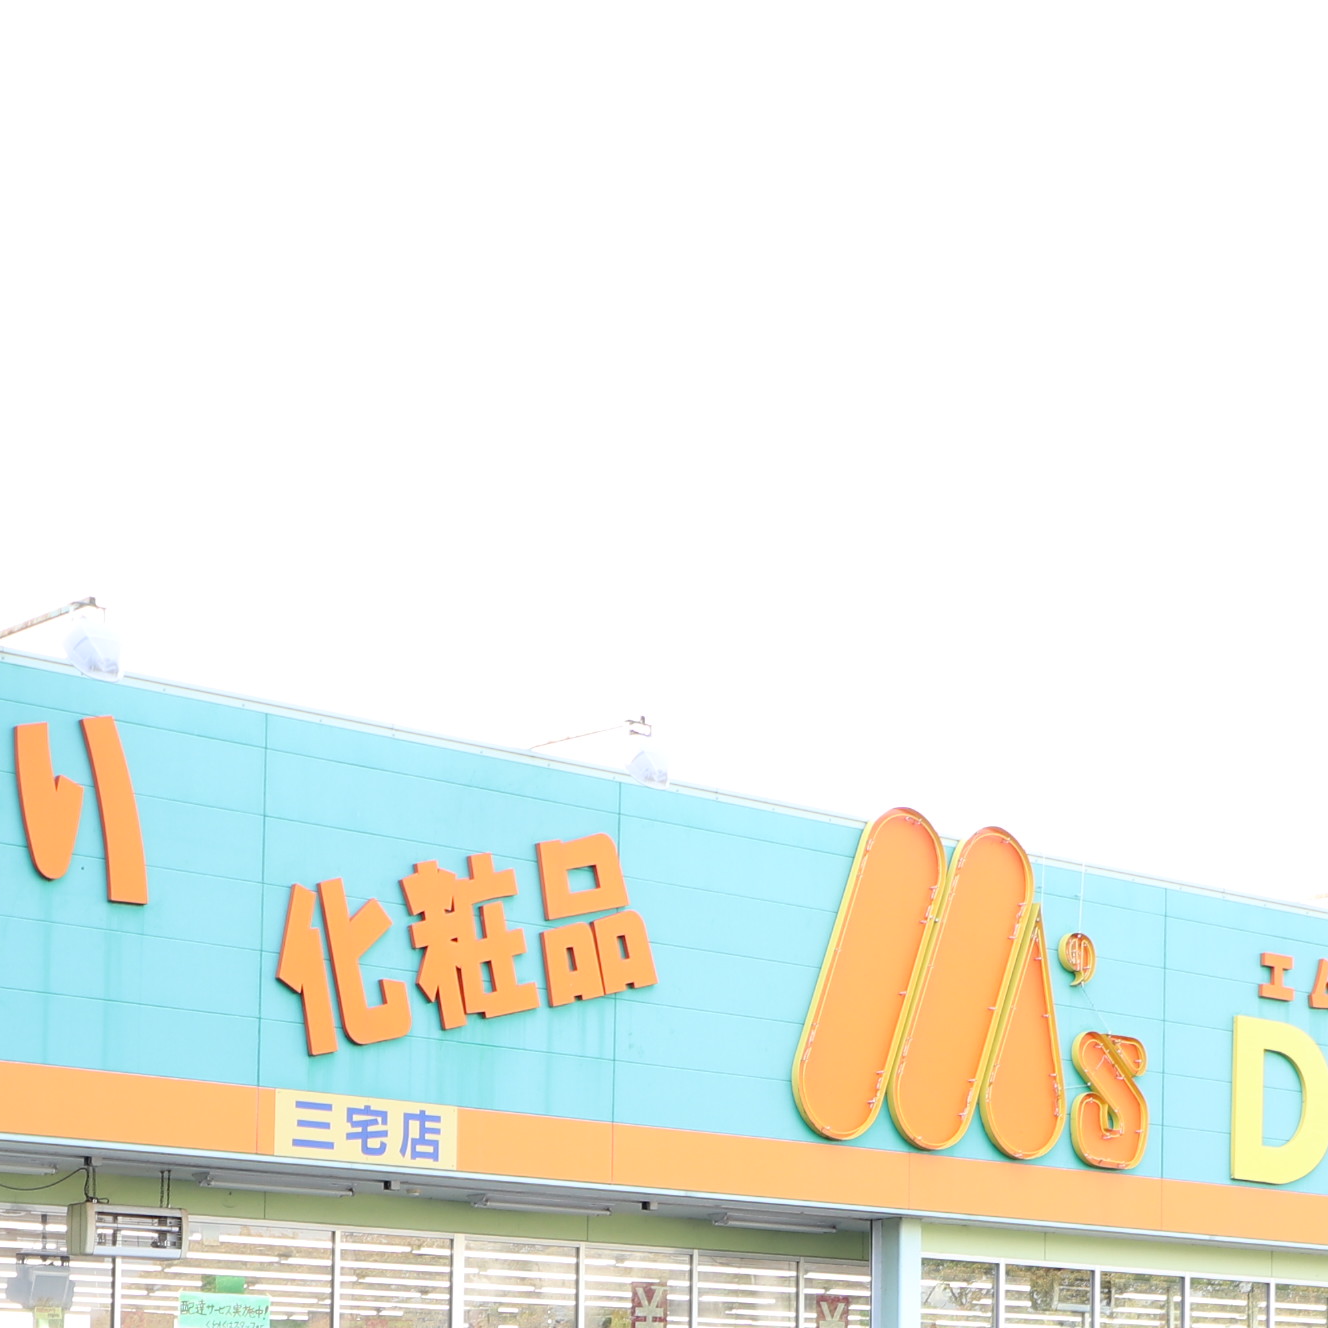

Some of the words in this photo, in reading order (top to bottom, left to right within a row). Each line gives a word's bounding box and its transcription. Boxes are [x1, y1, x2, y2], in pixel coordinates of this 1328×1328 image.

[276, 831, 660, 1056] 化粧品
[289, 1099, 442, 1164] 三宅店
